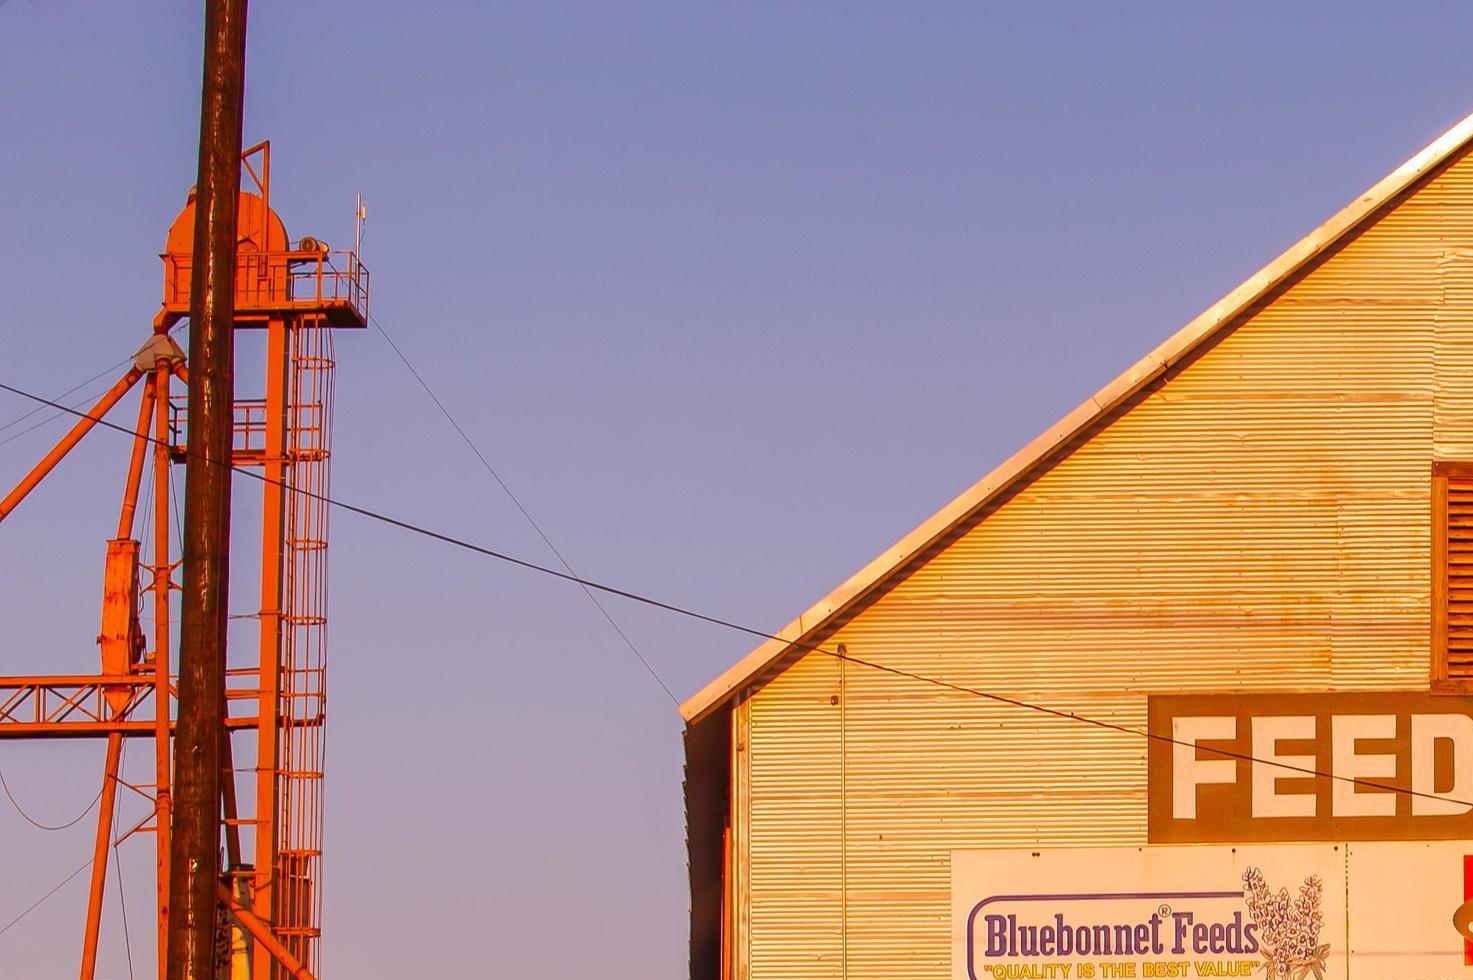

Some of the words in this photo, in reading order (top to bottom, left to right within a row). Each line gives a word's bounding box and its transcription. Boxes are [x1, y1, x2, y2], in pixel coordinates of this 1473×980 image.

[984, 912, 1164, 957] Bluebonnet
[1171, 911, 1260, 955] Feeds
[984, 963, 1072, 980] "QUALITY
[1077, 963, 1094, 978] IS
[1099, 962, 1137, 978] THE
[1142, 962, 1190, 977] BEST
[1195, 960, 1260, 977] VALUE"
